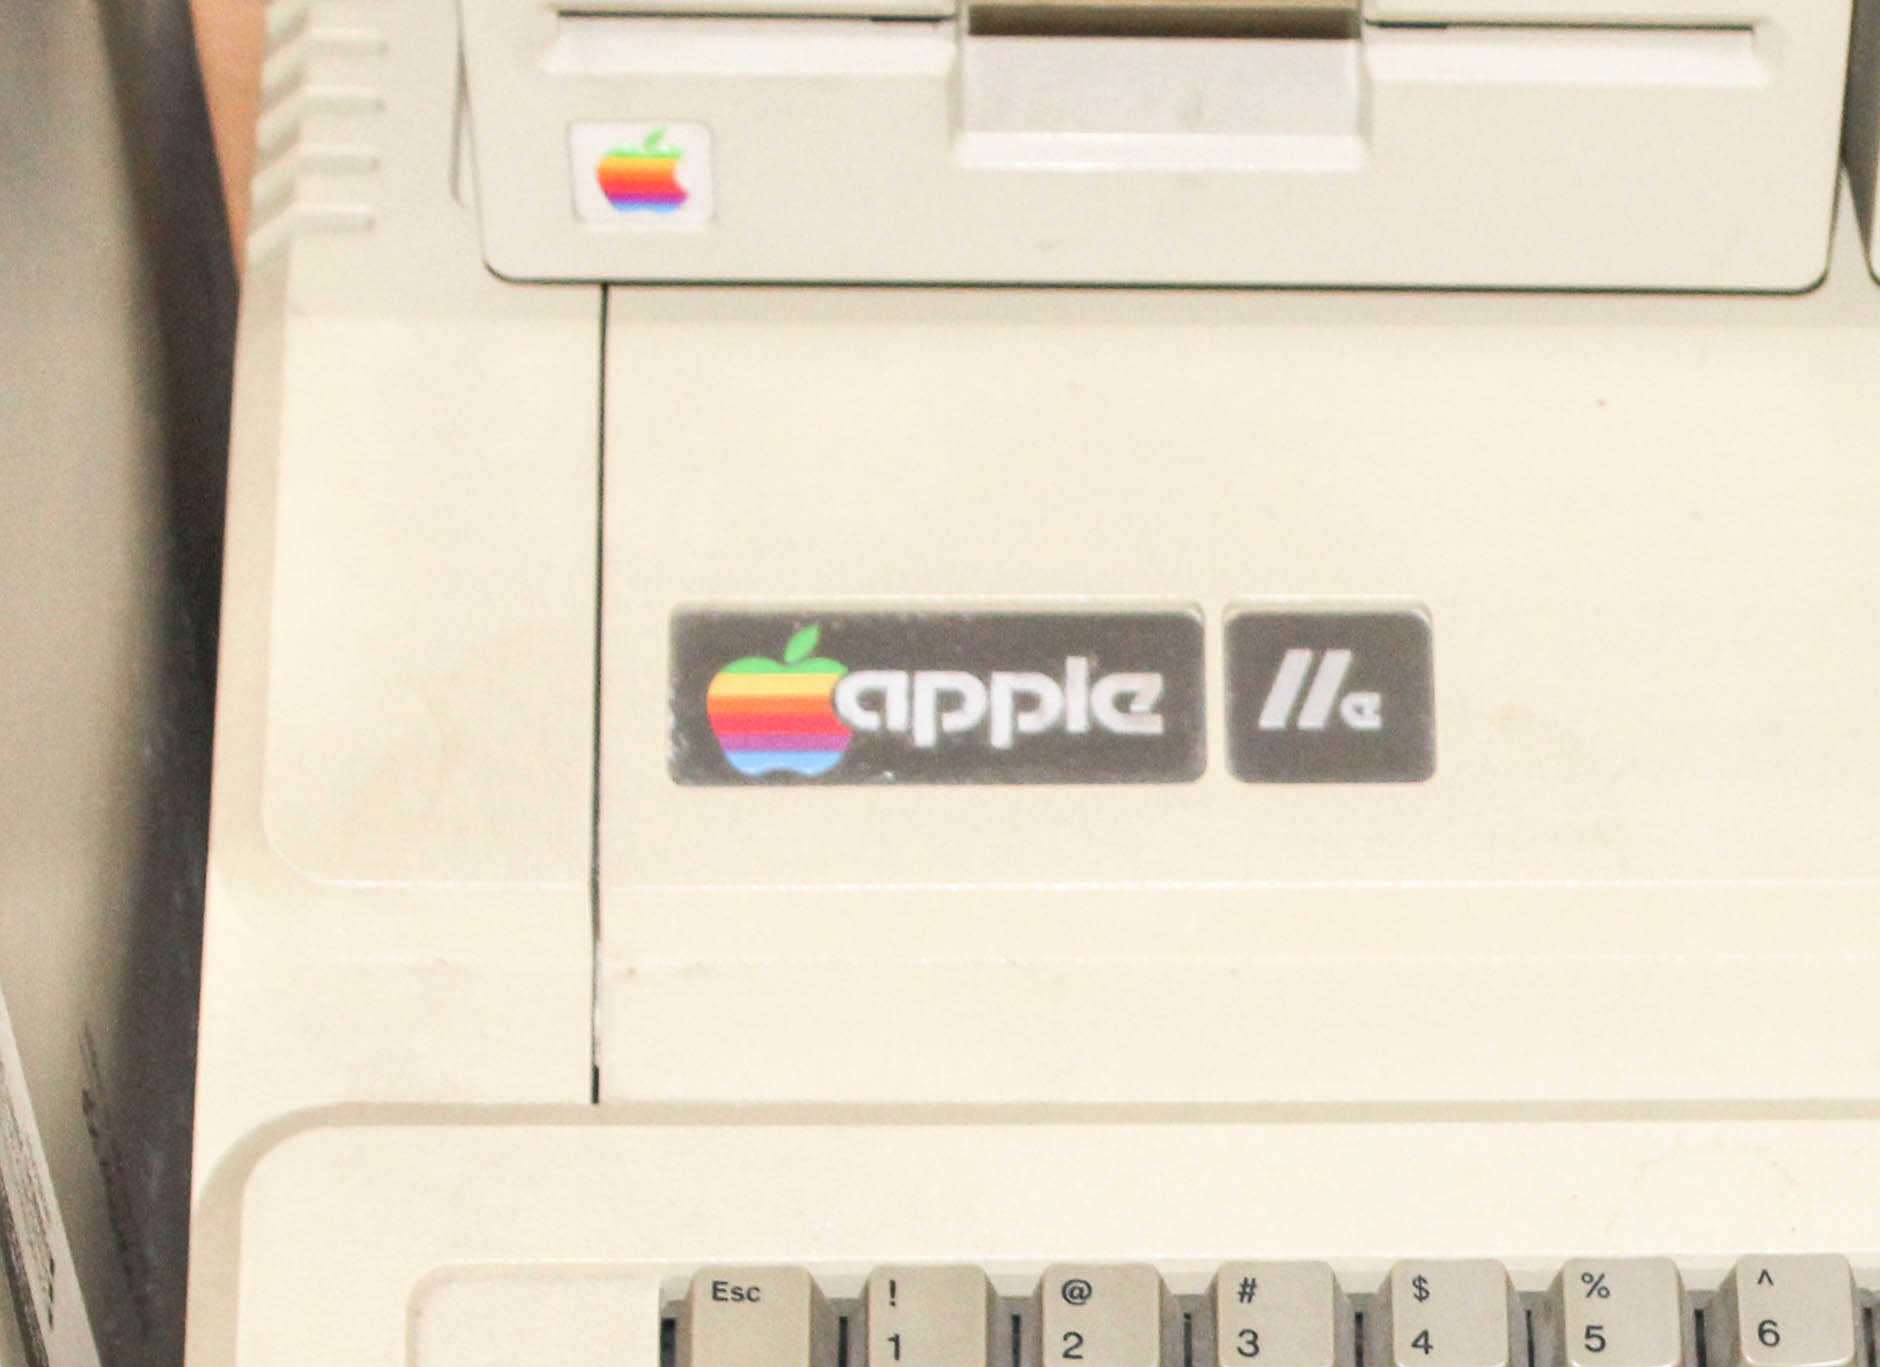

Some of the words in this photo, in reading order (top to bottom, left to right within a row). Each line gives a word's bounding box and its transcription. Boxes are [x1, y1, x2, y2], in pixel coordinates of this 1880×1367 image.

[834, 655, 1165, 749] apple
[711, 1280, 761, 1303] Esc
[889, 1279, 897, 1307] !
[1060, 1278, 1093, 1306] @
[1237, 1277, 1257, 1304] #
[1411, 1274, 1430, 1303] $
[1580, 1271, 1611, 1300] %
[887, 1333, 901, 1361] 1
[1062, 1331, 1084, 1360] 2
[1236, 1328, 1260, 1358] 3
[1410, 1329, 1434, 1355] 4
[1584, 1324, 1607, 1353] 5
[1757, 1319, 1781, 1347] 6
